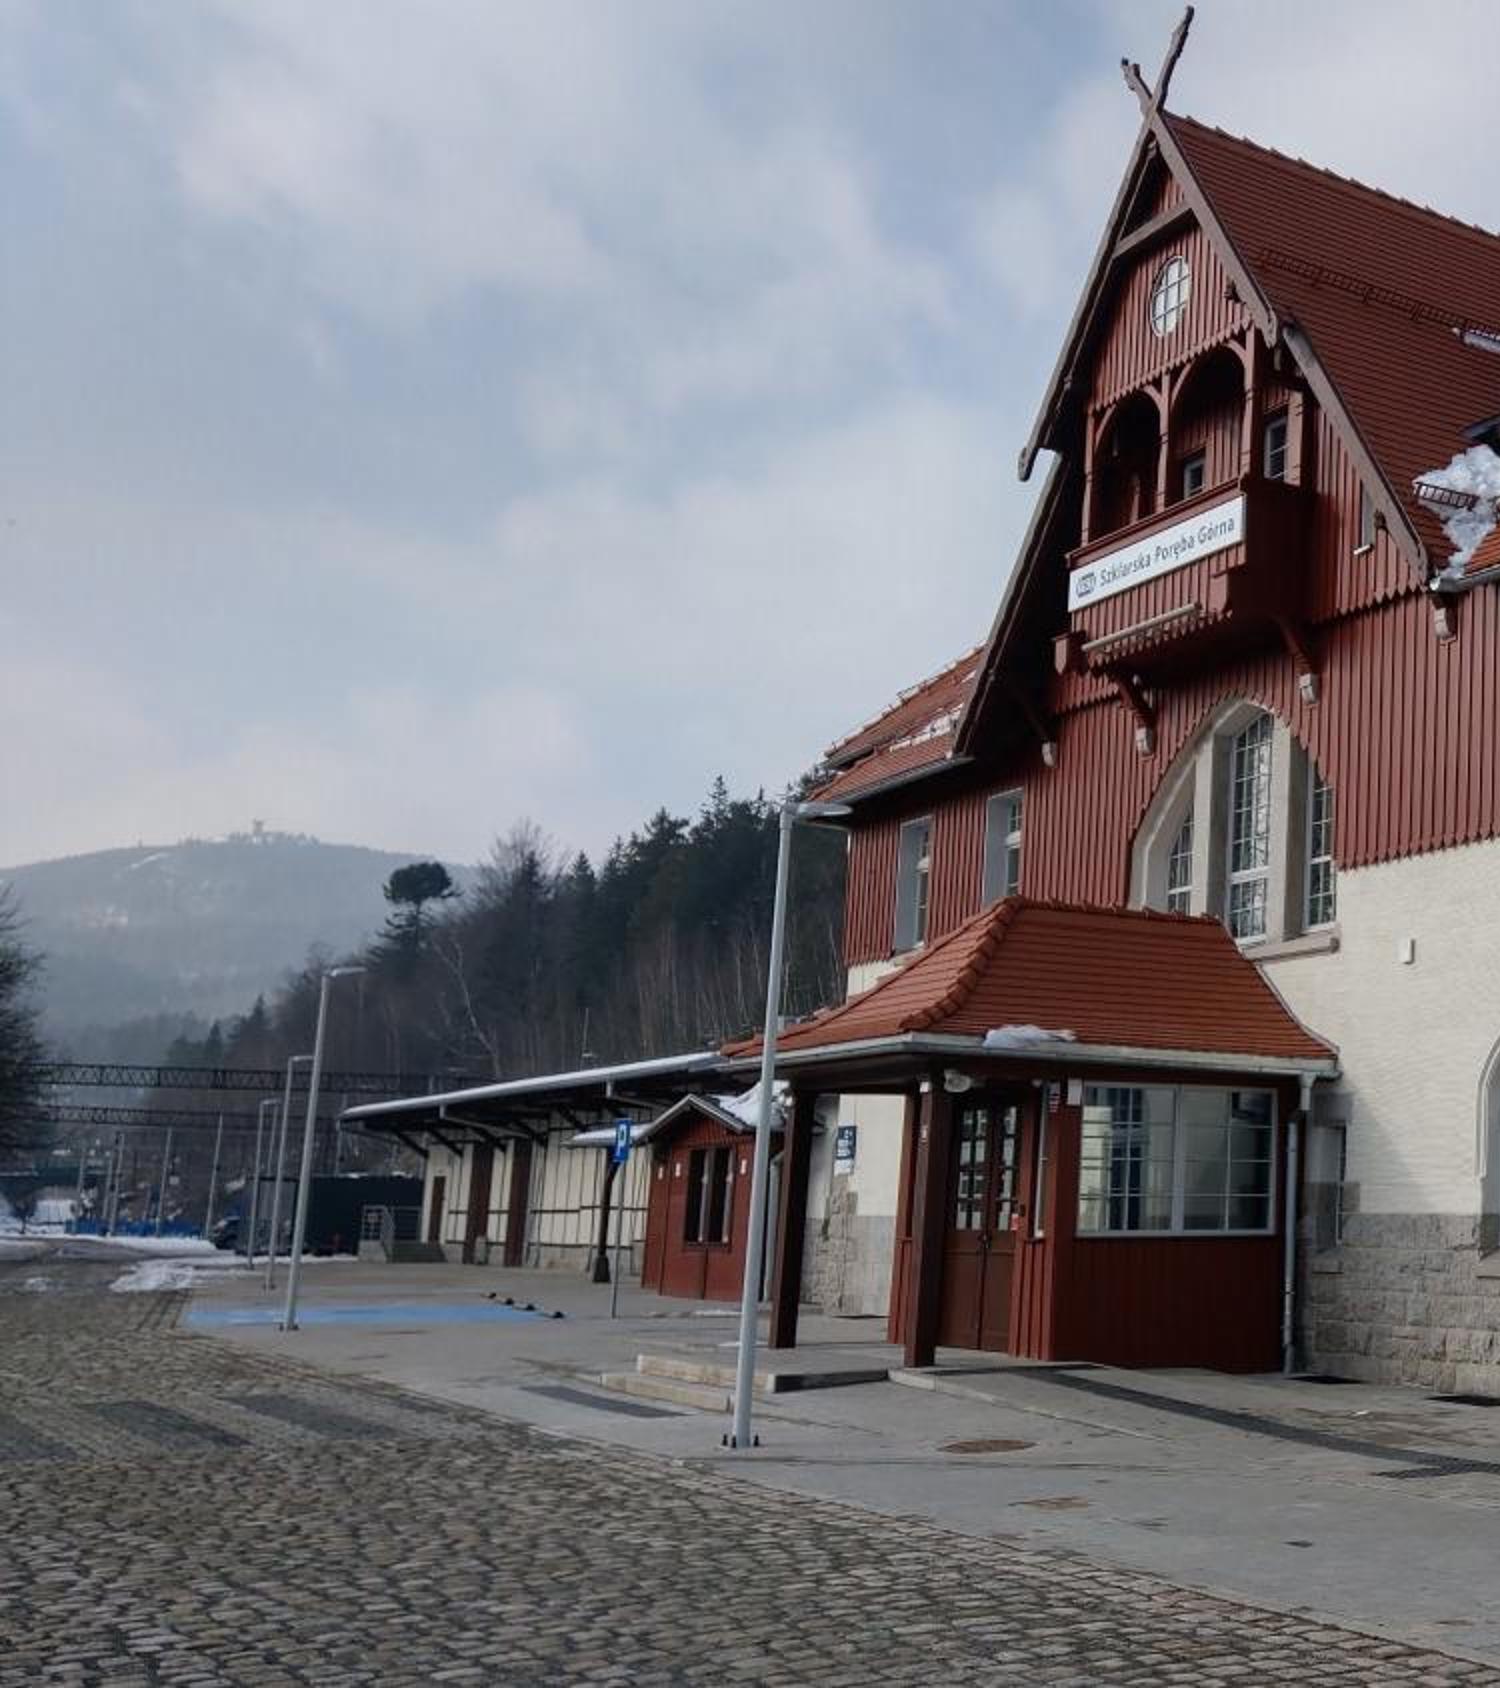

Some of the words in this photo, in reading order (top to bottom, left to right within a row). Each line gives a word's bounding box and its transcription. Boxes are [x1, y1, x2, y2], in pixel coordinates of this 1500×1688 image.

[1100, 554, 1151, 587] Szklarska
[1154, 536, 1195, 562] Poręba
[1198, 518, 1235, 543] Górna
[616, 1123, 627, 1157] P
